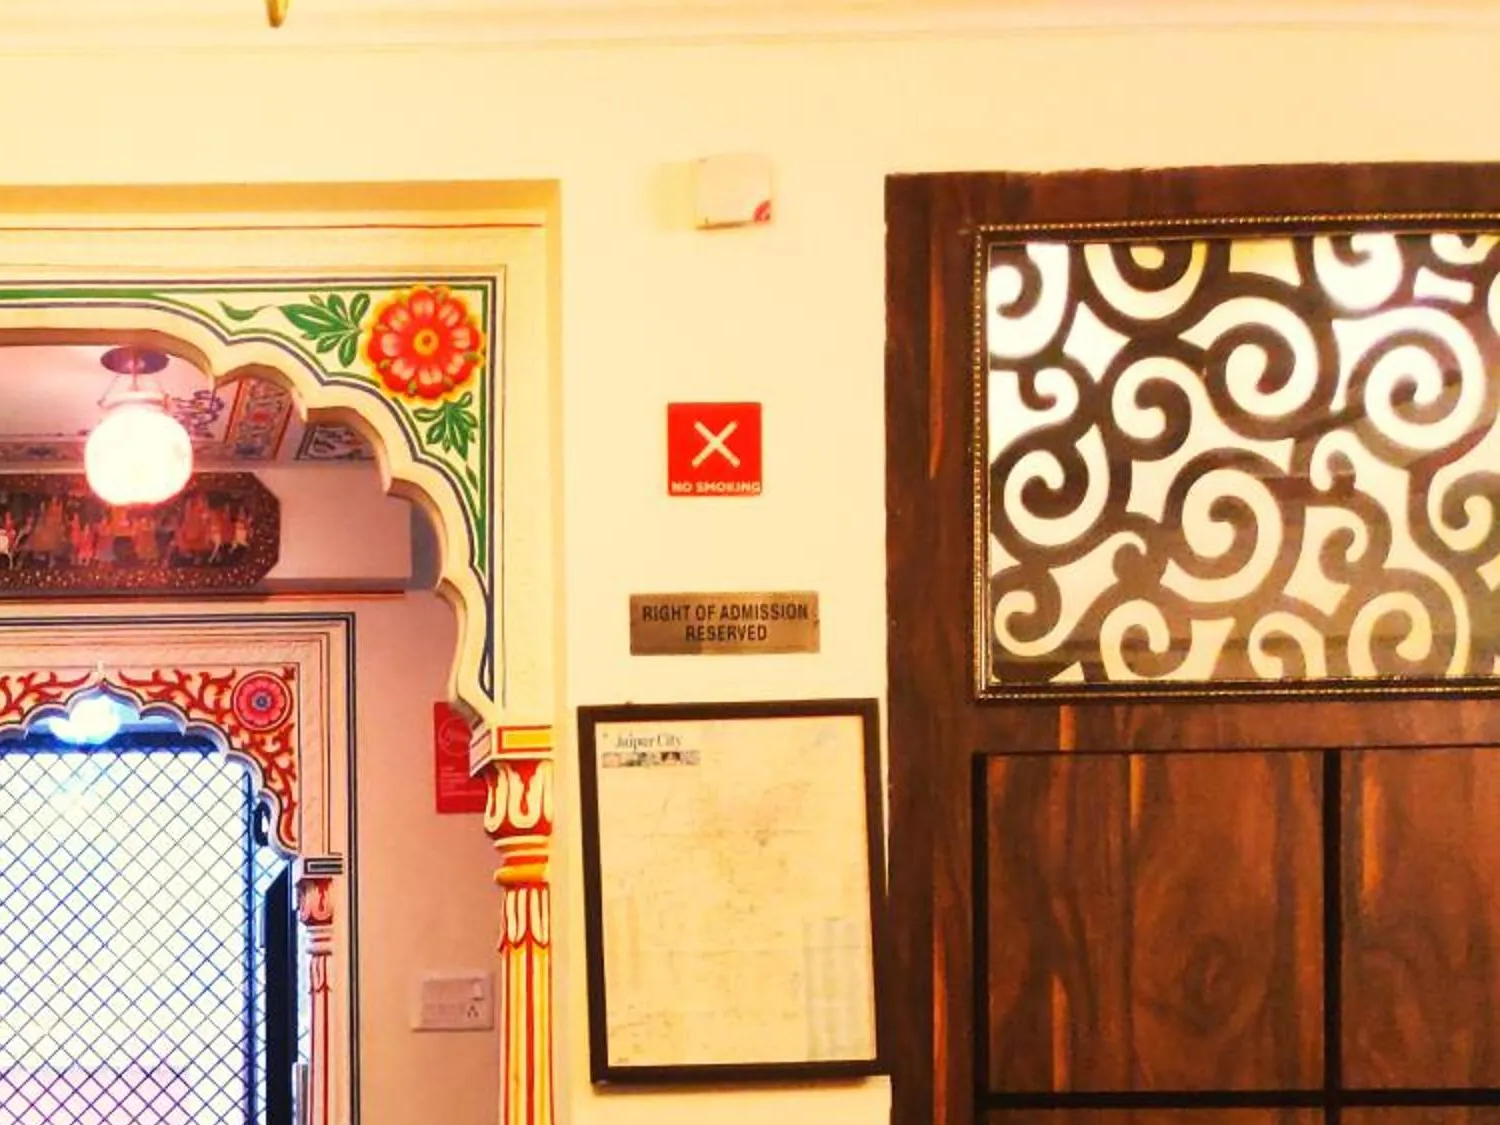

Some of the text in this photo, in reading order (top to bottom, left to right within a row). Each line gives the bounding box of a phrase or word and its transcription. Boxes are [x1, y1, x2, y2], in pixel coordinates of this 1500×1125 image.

[671, 481, 761, 493] NO SMOKING
[642, 603, 808, 622] RIGHT OF ADMISSION
[685, 624, 767, 642] RESERVED
